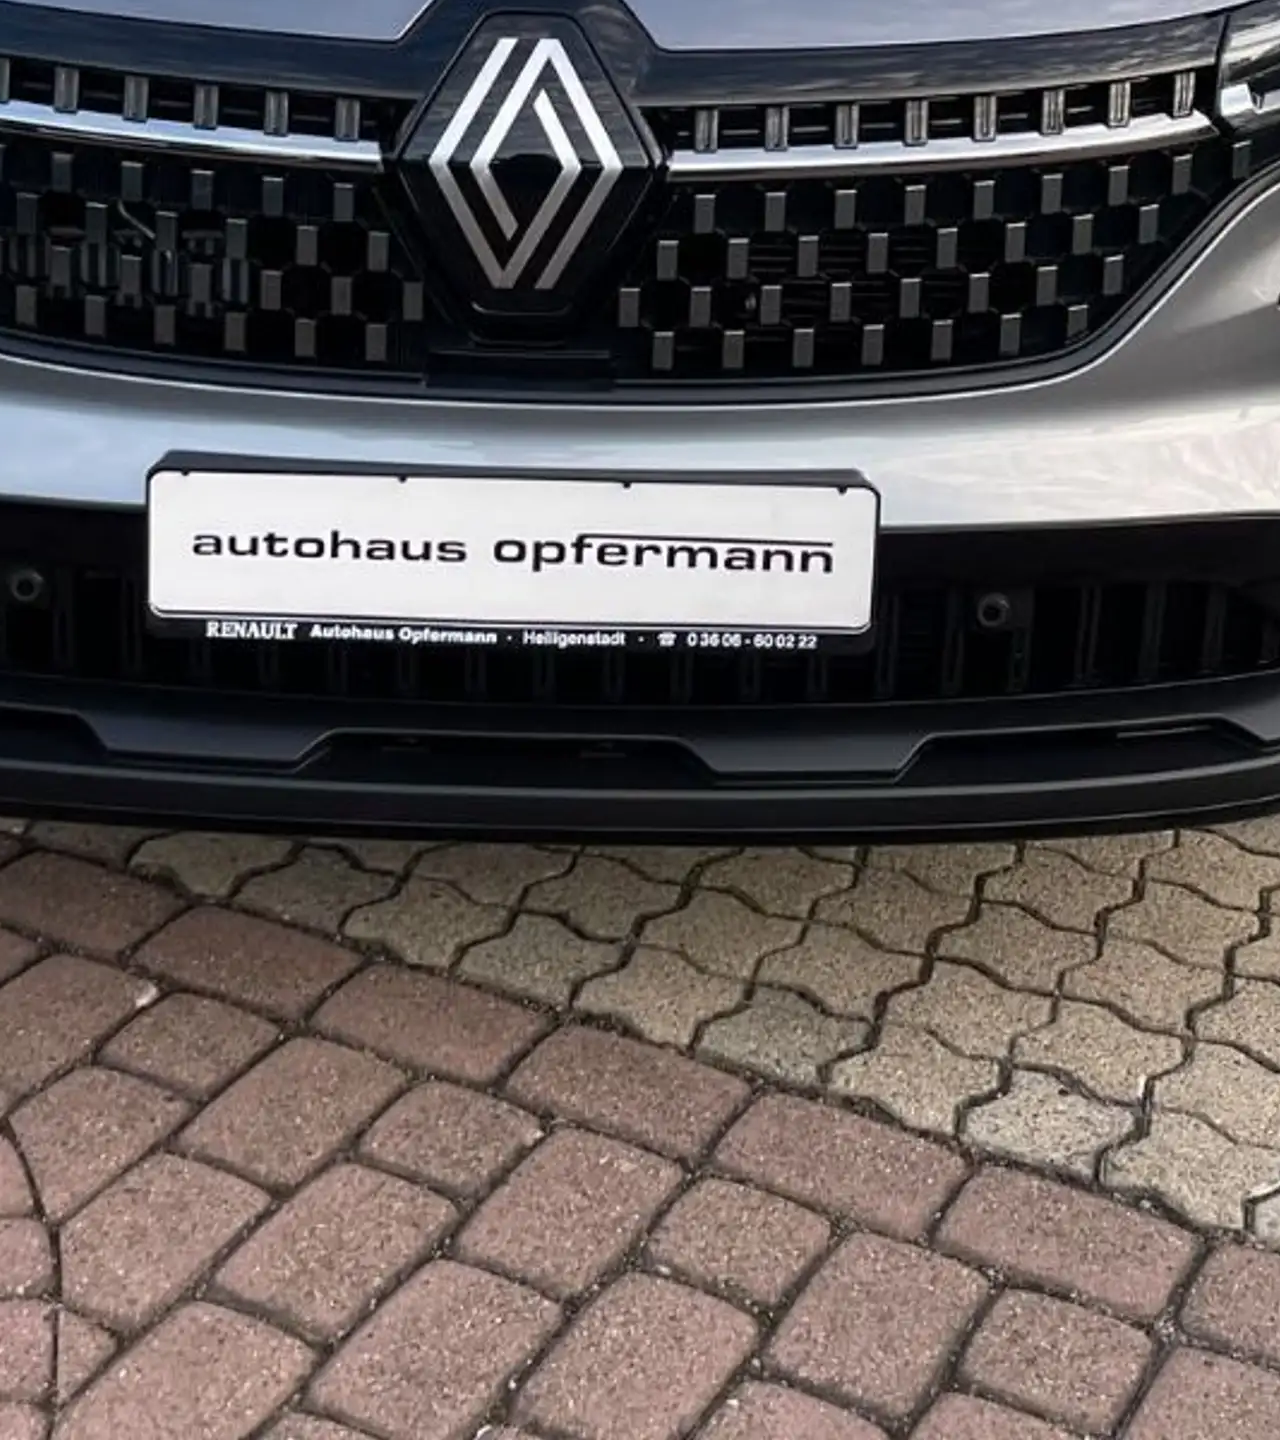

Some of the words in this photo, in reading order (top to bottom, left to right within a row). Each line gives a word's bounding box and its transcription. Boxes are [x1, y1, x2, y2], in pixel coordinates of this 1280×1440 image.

[192, 529, 468, 563] autohaus
[492, 532, 834, 574] opfermann
[205, 620, 298, 640] RENAULT
[309, 623, 395, 641] Autohaus
[397, 626, 497, 645] Opfermann
[522, 630, 625, 649] Heiligenstadt
